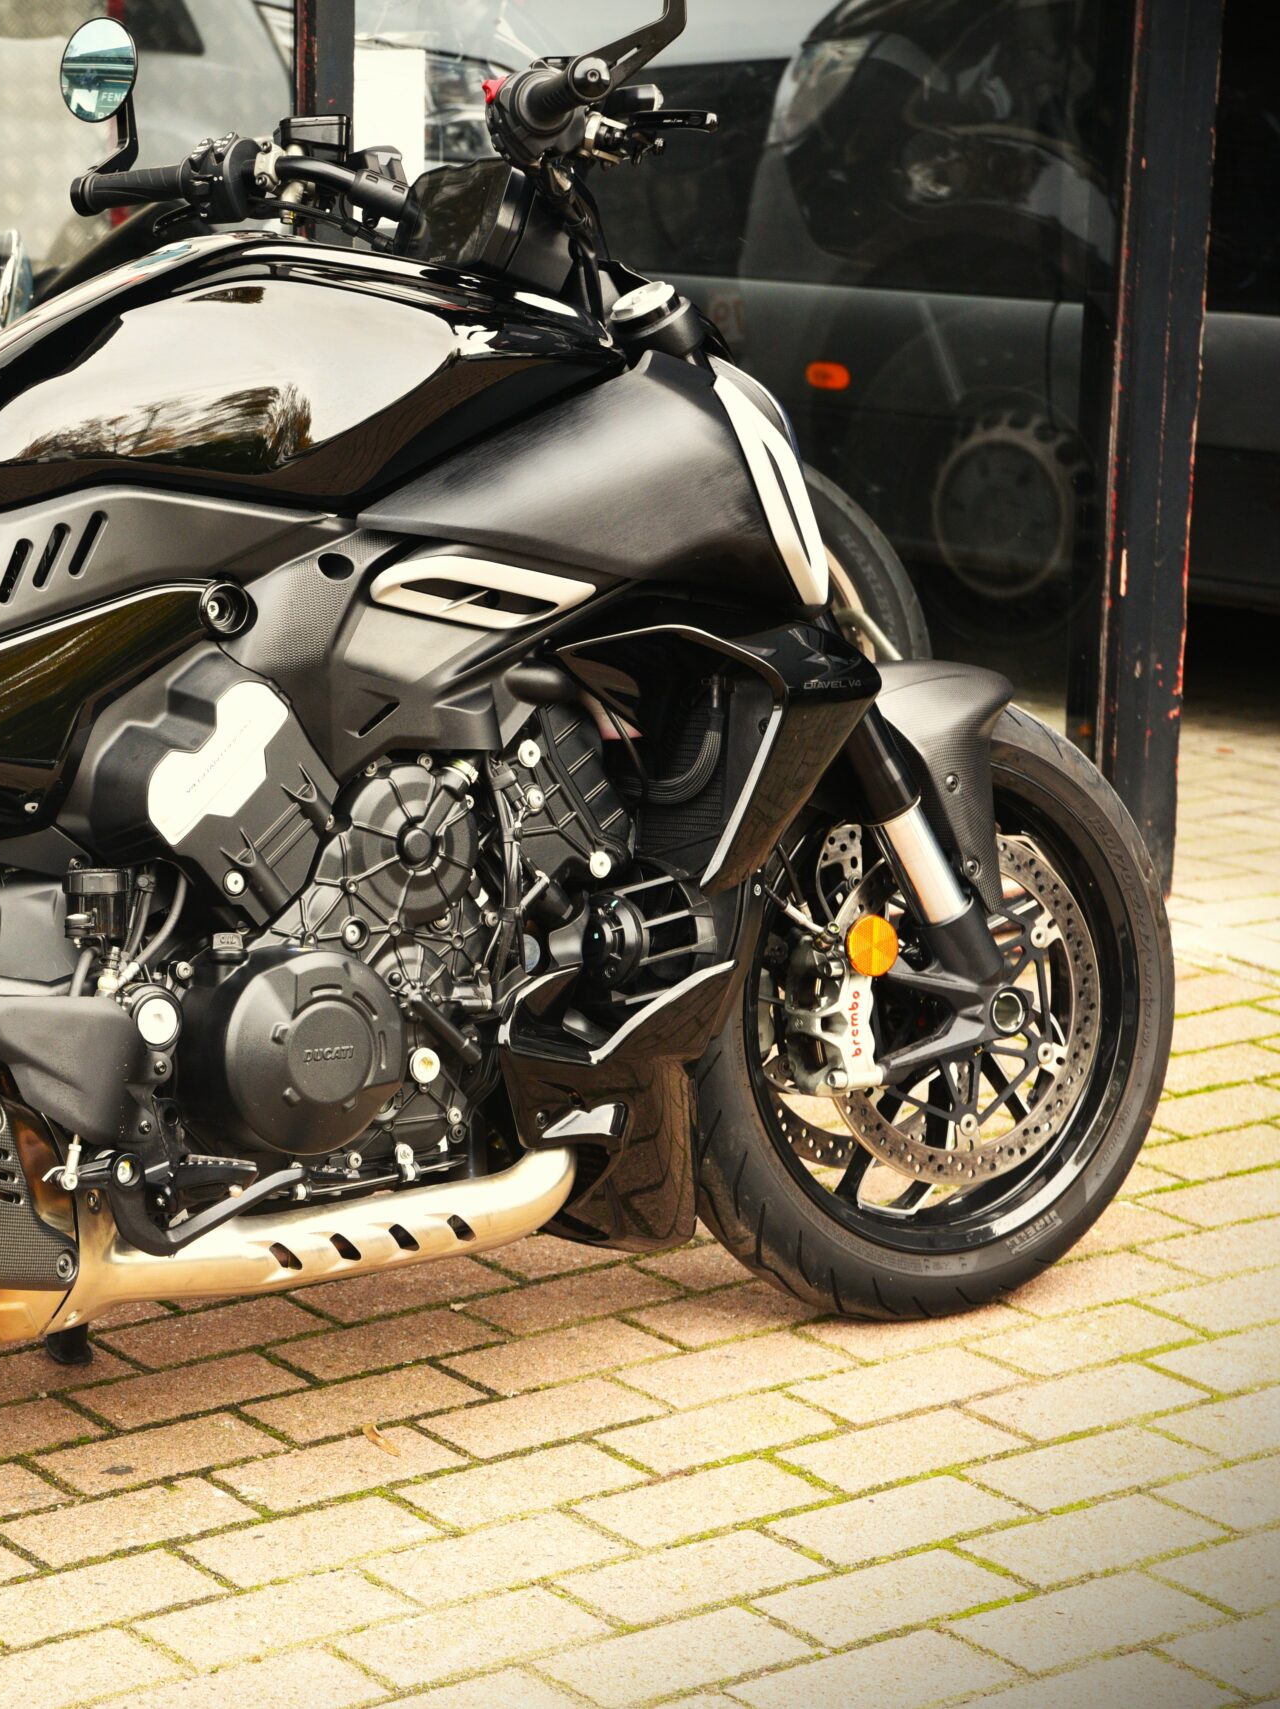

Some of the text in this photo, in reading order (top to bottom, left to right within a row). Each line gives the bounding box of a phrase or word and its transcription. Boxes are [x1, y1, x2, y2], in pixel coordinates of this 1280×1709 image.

[803, 679, 862, 690] DIAVEL V4
[219, 934, 237, 945] OIL
[848, 990, 864, 1058] brembo
[303, 1045, 355, 1063] DUCATI
